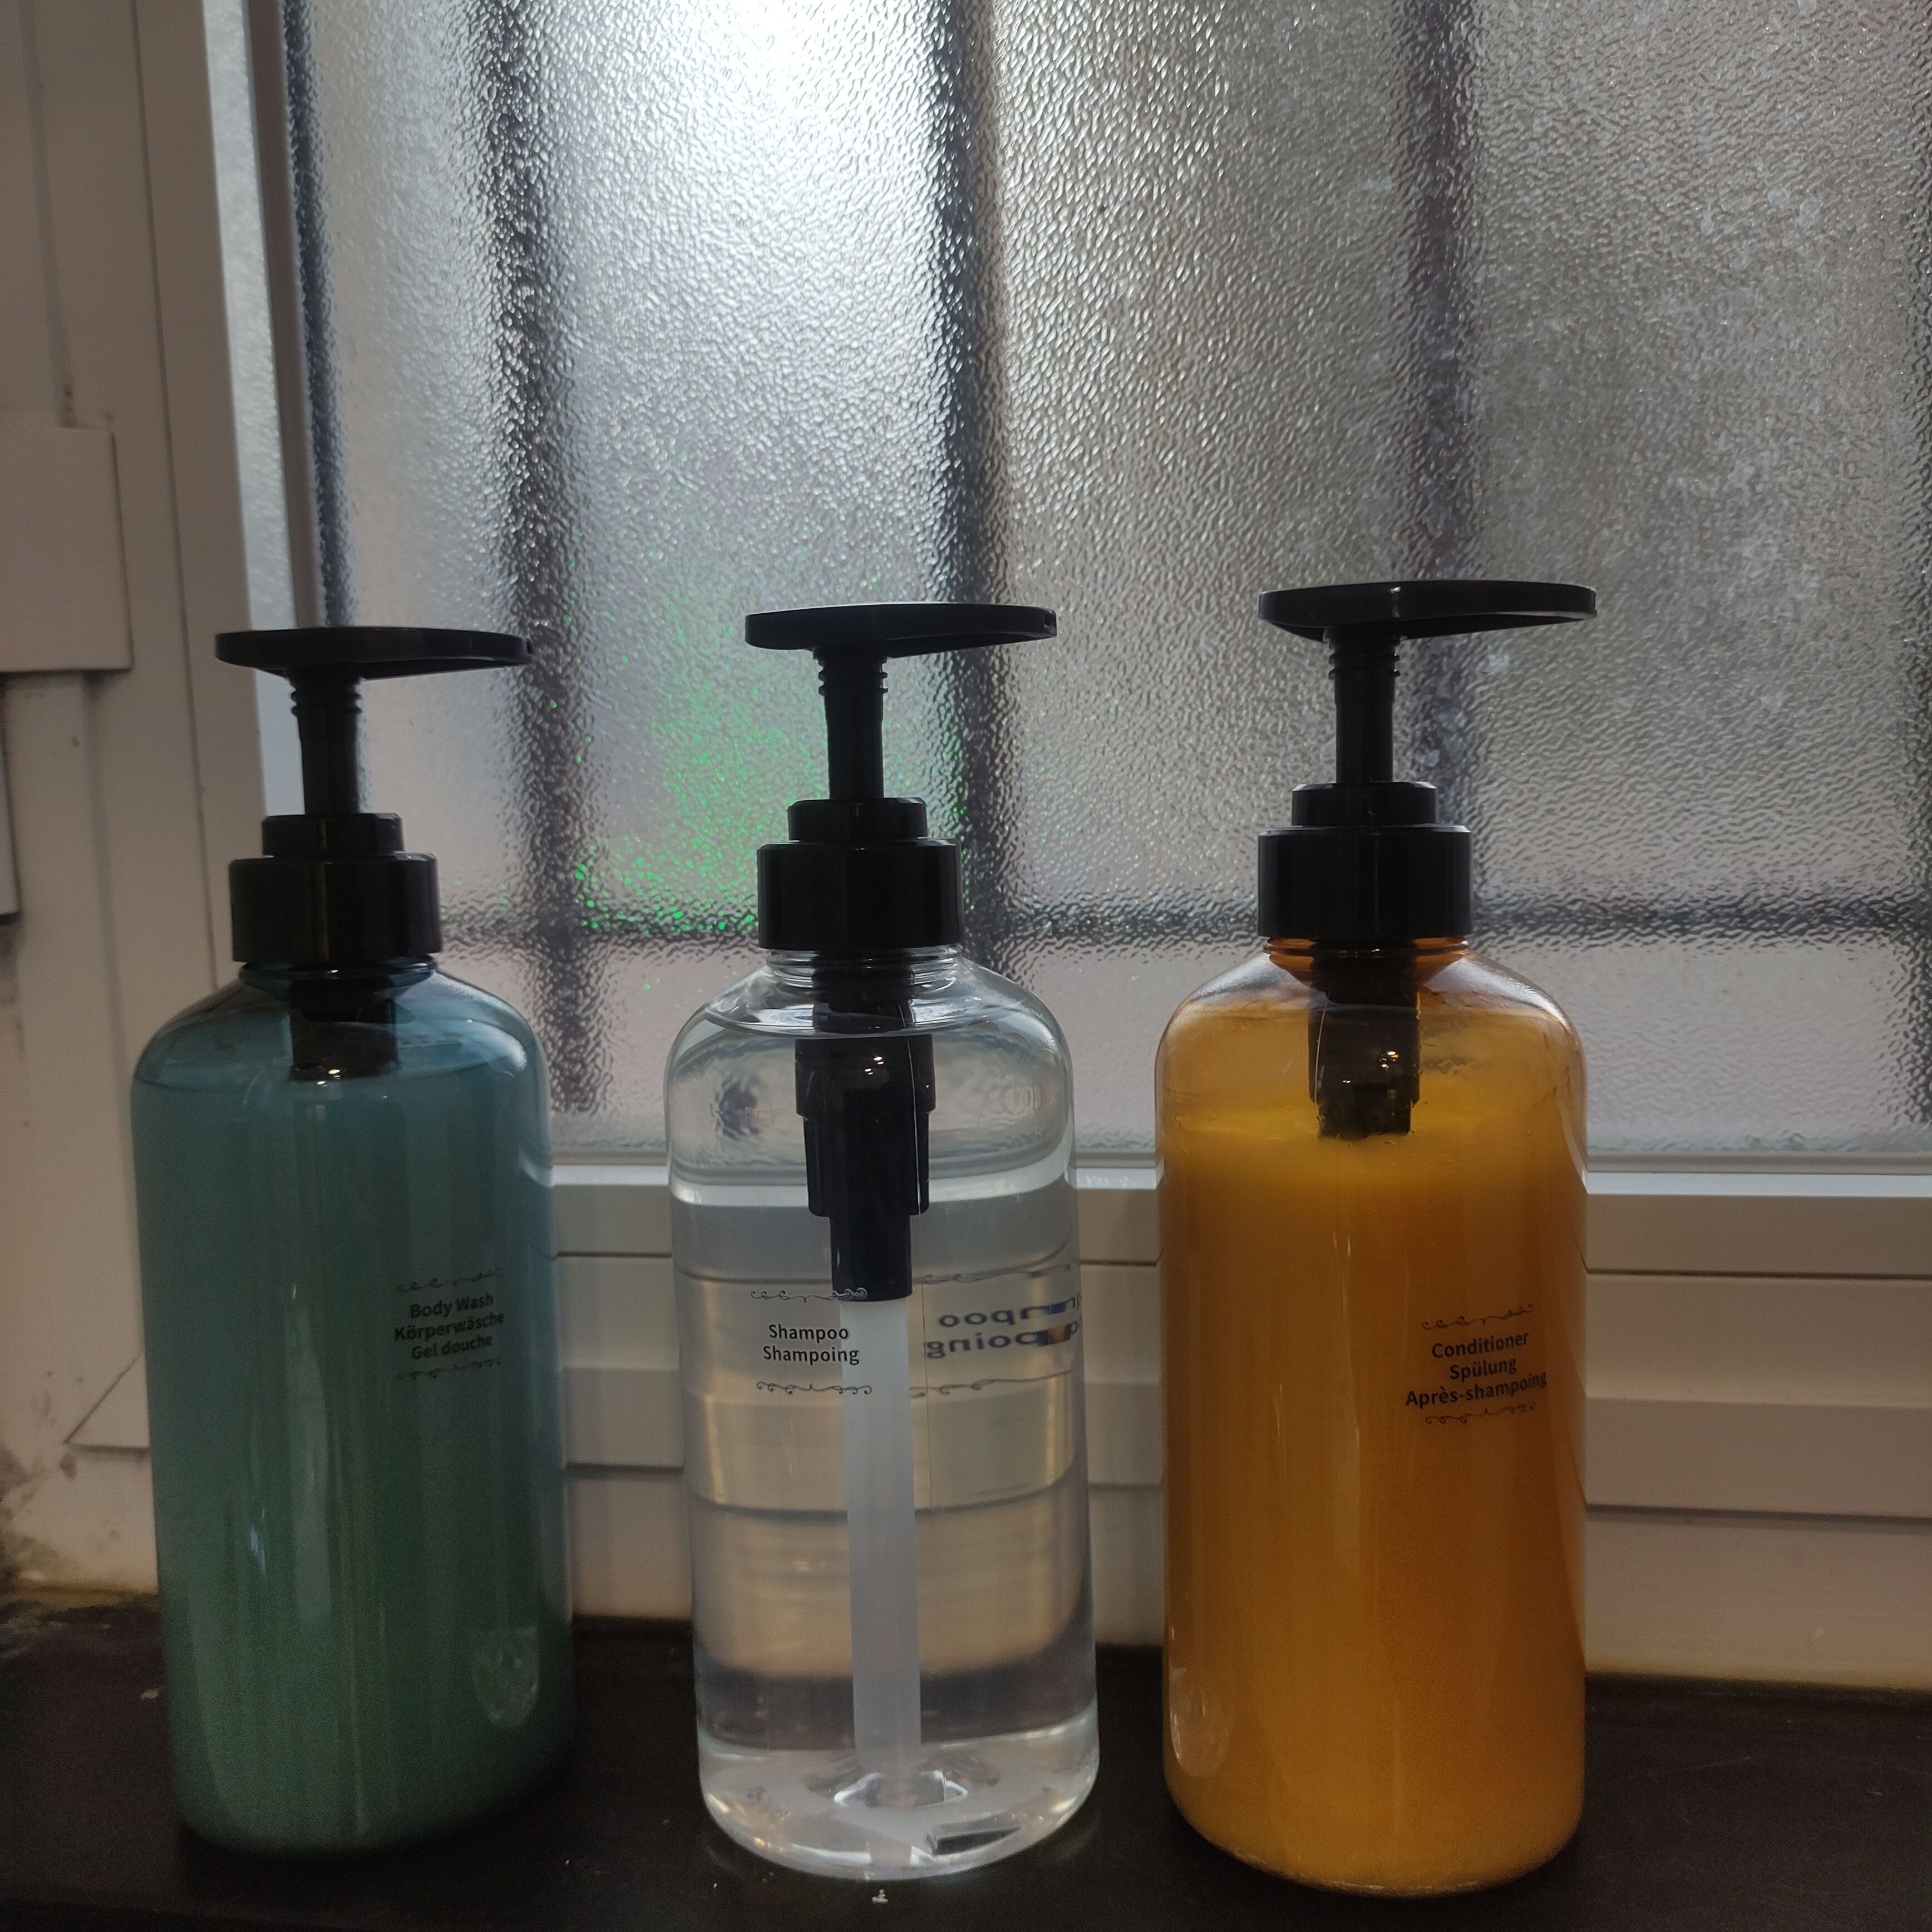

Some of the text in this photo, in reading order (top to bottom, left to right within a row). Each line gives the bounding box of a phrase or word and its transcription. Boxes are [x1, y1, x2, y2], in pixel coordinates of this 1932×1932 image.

[410, 1292, 494, 1318] Body Wash
[394, 1312, 505, 1340] Körperwäsche
[768, 1324, 849, 1344] Shampoo
[411, 1335, 492, 1359] Gel douche
[763, 1345, 860, 1366] Shampoing
[1432, 1332, 1529, 1358] Conditioner
[1450, 1358, 1517, 1382] Spülung
[1406, 1372, 1547, 1408] Après-shampoing
